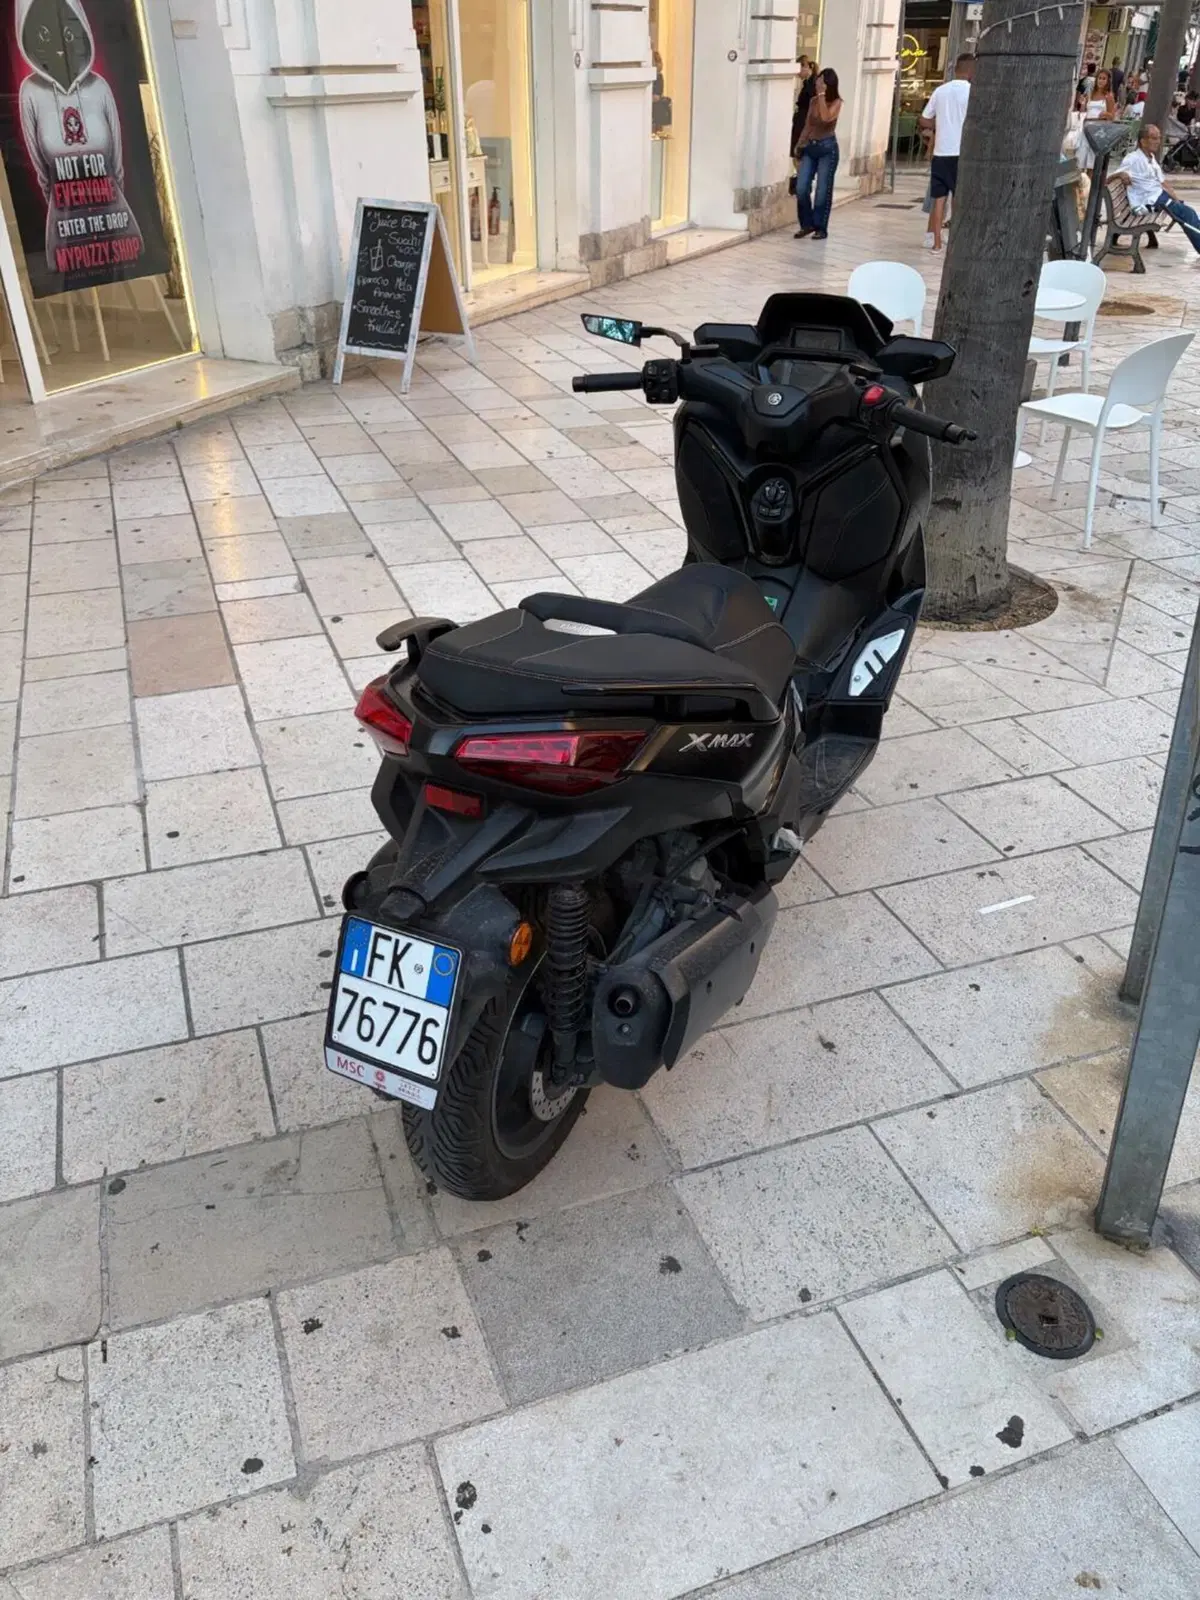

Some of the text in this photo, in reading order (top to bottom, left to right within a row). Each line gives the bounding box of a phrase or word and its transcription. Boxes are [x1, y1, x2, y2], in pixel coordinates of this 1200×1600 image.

[55, 153, 107, 181] NOT FOR
[54, 178, 117, 208] EVERYONE
[58, 211, 129, 237] ENTER THE DROP
[370, 212, 398, 232] Juice
[56, 237, 140, 272] MYPUZZY.SHOP
[367, 931, 412, 989] FK
[337, 987, 440, 1065] 76776
[336, 1056, 365, 1077] MSC
